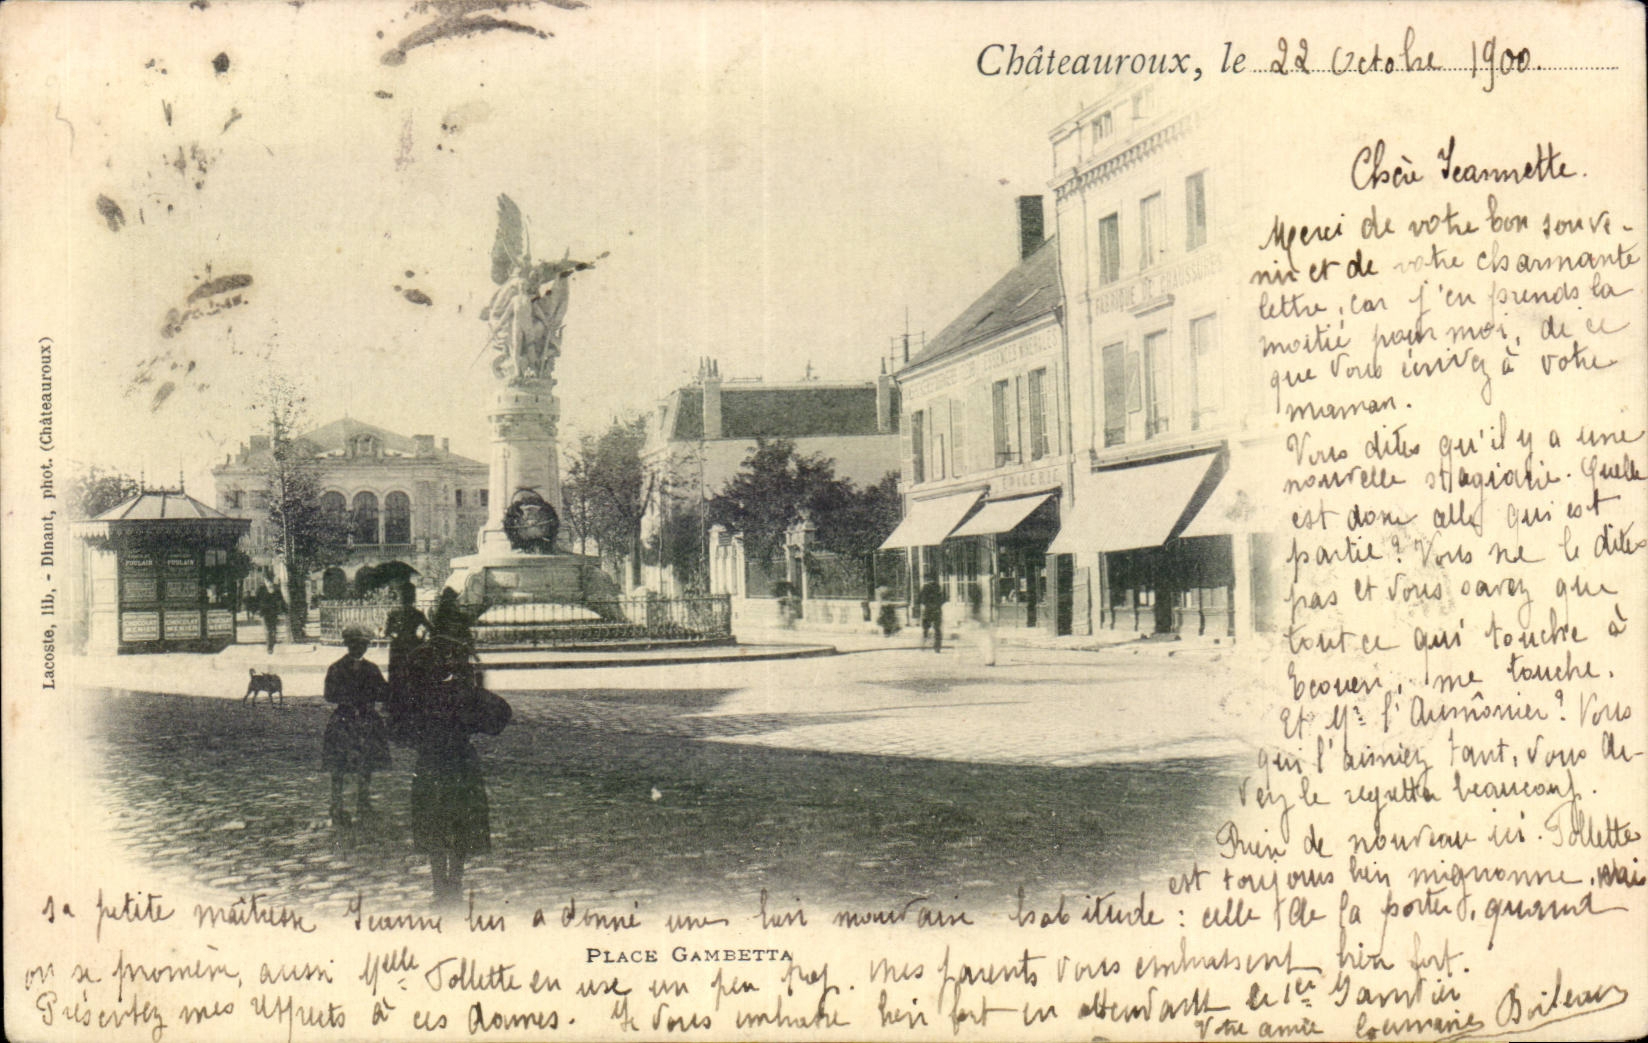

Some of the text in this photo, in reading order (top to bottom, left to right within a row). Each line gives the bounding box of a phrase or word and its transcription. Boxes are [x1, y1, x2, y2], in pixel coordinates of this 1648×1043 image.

[1268, 39, 1311, 76] 22
[1258, 213, 1345, 254] Merci
[1361, 205, 1396, 239] de
[1408, 202, 1480, 237] votre
[1488, 194, 1528, 234] bon
[1309, 261, 1340, 283] et
[1346, 248, 1379, 278] de
[1393, 243, 1464, 274] votre
[1476, 240, 1642, 274] charmante
[1350, 297, 1389, 314] car
[1488, 283, 1580, 325] prends
[1591, 272, 1636, 299] la
[1260, 319, 1353, 358] moitié
[1372, 322, 1437, 360] pour
[1541, 315, 1569, 341] de
[1585, 315, 1631, 335] ce
[1269, 365, 1318, 414] que
[1401, 346, 1493, 400] écrivez
[1501, 346, 1521, 374] à
[1541, 340, 1620, 377] votre
[1287, 430, 1349, 466] Vous
[1364, 424, 1421, 459] dites
[1516, 428, 1534, 462] y
[1549, 428, 1562, 448] a
[1576, 425, 1647, 449] une
[1283, 465, 1406, 494] nouvelle
[1581, 454, 1648, 490] Quelle
[1292, 488, 1621, 546] est donc celle qui est
[1489, 542, 1547, 564] ne
[1558, 526, 1580, 561] le
[1593, 521, 1648, 557] dites
[1284, 582, 1339, 625] pas
[1354, 577, 1377, 602] et
[1460, 576, 1535, 629] savez
[1555, 575, 1619, 624] que
[1284, 603, 1629, 682] tout ce qui touche à
[1433, 668, 1483, 693] me
[1280, 706, 1310, 740] Et
[1579, 690, 1633, 731] Vous
[1256, 745, 1302, 788] qui
[1300, 776, 1330, 806] le
[1215, 820, 1286, 860] Rien
[1304, 823, 1333, 857] de
[1348, 823, 1476, 854] nouveau
[1168, 860, 1209, 894] est
[1223, 862, 1335, 920] toujours
[1349, 856, 1391, 889] bien
[42, 894, 76, 923] sa
[95, 888, 176, 942] petite
[193, 893, 317, 934] maîtresse
[342, 893, 443, 933] Jeanne
[468, 890, 506, 932] lui
[532, 907, 546, 926] a
[560, 896, 642, 932] donné
[665, 914, 729, 933] une
[758, 888, 809, 930] bien
[833, 895, 974, 929] mauvaise
[1202, 897, 1261, 928] celle
[1288, 897, 1327, 924] de
[1338, 890, 1362, 928] la
[1485, 892, 1629, 945] quand
[25, 961, 55, 990] on
[71, 963, 101, 985] se
[259, 958, 334, 986] aussi
[529, 970, 562, 993] en
[576, 976, 632, 998] use
[648, 976, 689, 997] un
[710, 966, 760, 1012] peu
[937, 945, 1046, 1012] parents
[1135, 937, 1322, 980] embrassent
[1337, 928, 1395, 972] bien
[35, 990, 165, 1041] Présentez
[179, 1001, 235, 1025] mes
[250, 996, 347, 1040] respects
[370, 995, 396, 1026] à
[411, 1008, 449, 1031] ces
[609, 996, 640, 1033] Je
[734, 996, 852, 1030] embrasse
[878, 988, 928, 1030] bien
[948, 983, 1019, 1035] fort
[1023, 1001, 1058, 1026] en
[1077, 987, 1230, 1023] attendant
[1246, 982, 1277, 1011] le
[1259, 1017, 1324, 1038] amie
